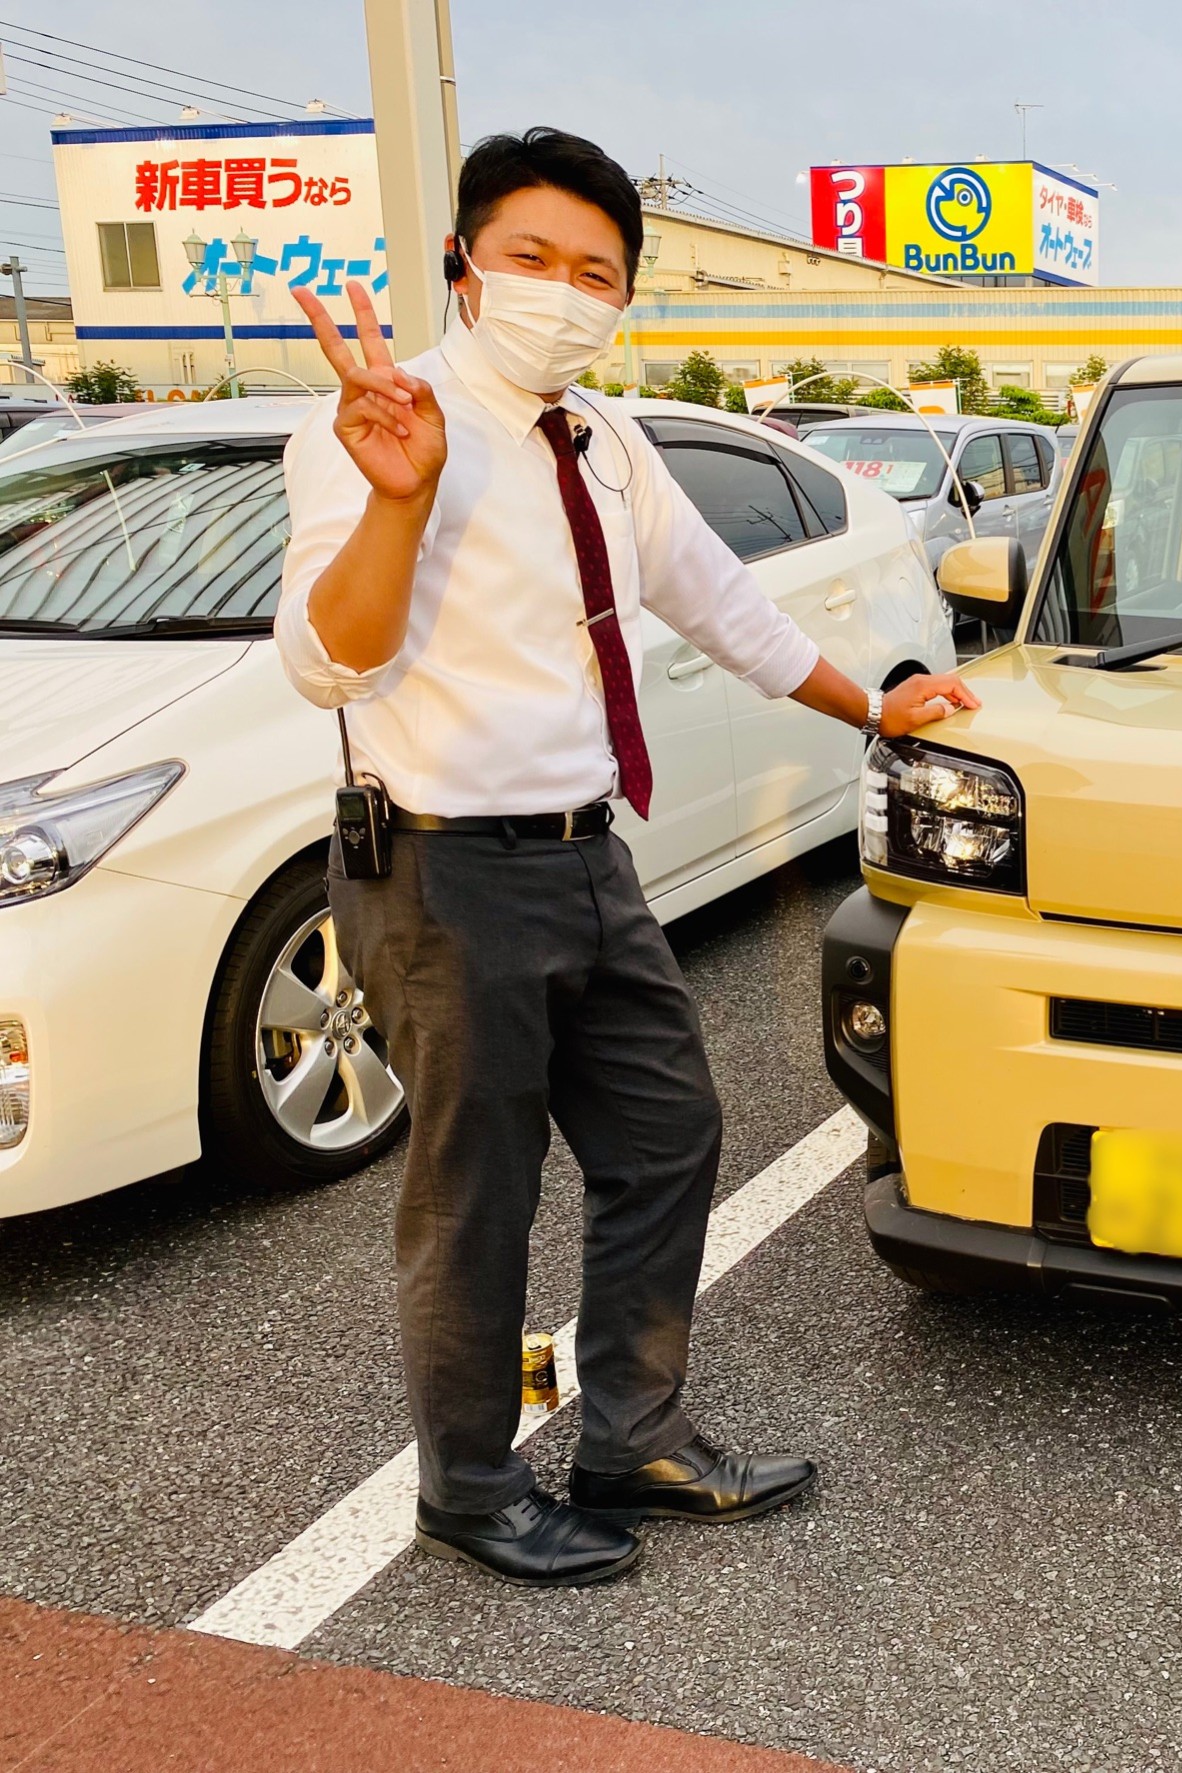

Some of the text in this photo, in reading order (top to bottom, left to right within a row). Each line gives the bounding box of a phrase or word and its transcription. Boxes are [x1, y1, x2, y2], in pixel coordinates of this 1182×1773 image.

[135, 158, 352, 212] 新車買うなら
[904, 243, 1016, 273] BunBun
